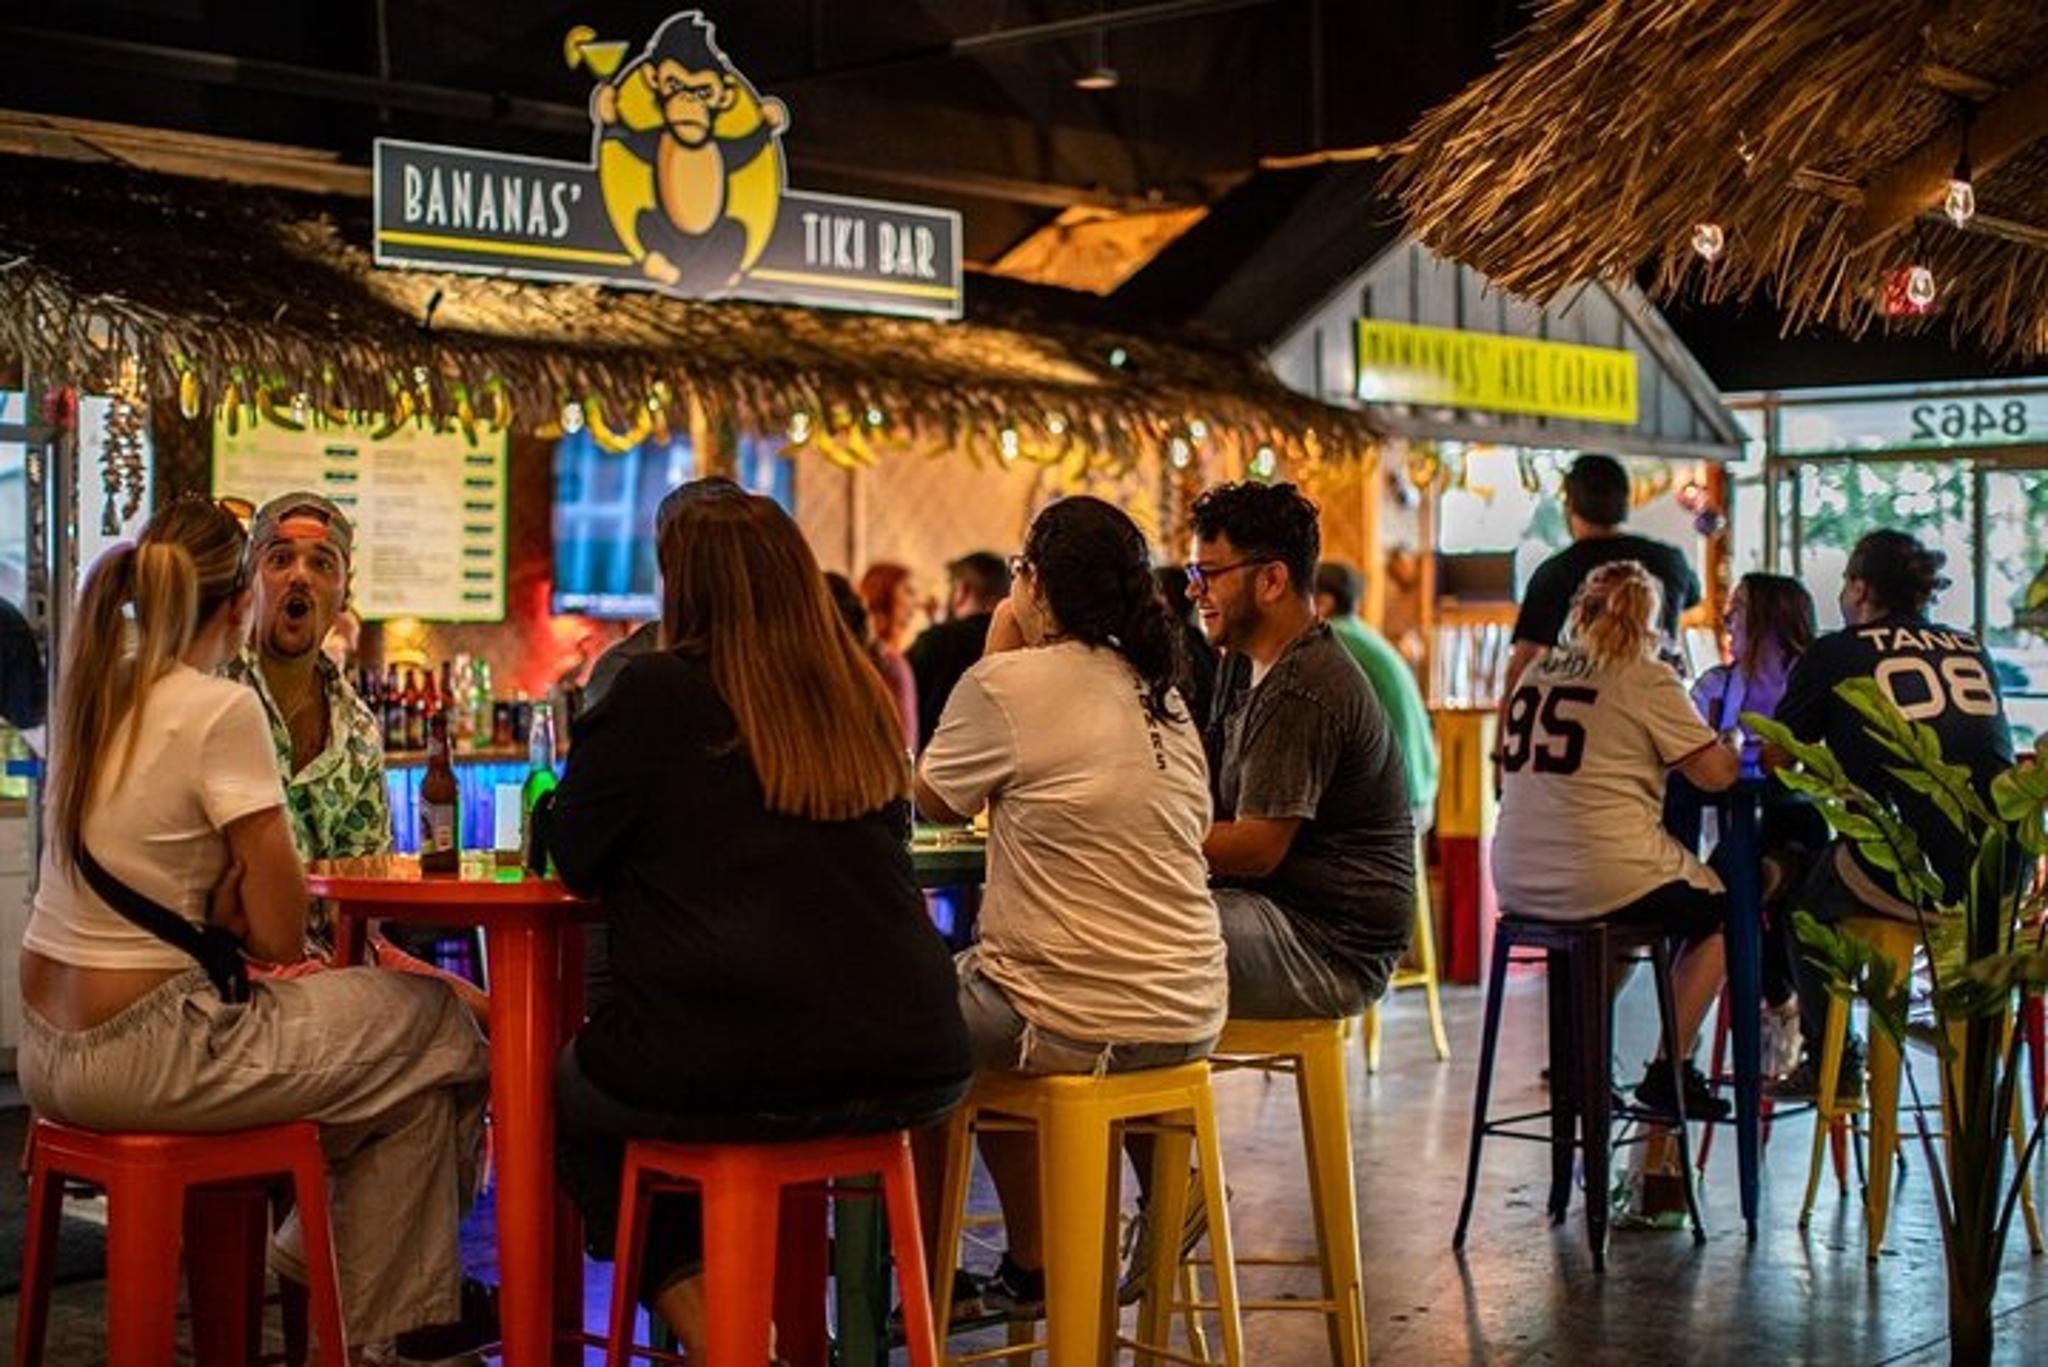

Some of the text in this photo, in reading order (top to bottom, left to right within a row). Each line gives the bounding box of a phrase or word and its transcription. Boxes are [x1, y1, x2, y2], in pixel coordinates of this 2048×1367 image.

[402, 164, 937, 279] BANANAS' TIKI BAR
[1502, 685, 1598, 776] 95
[1874, 656, 1998, 721] 08
